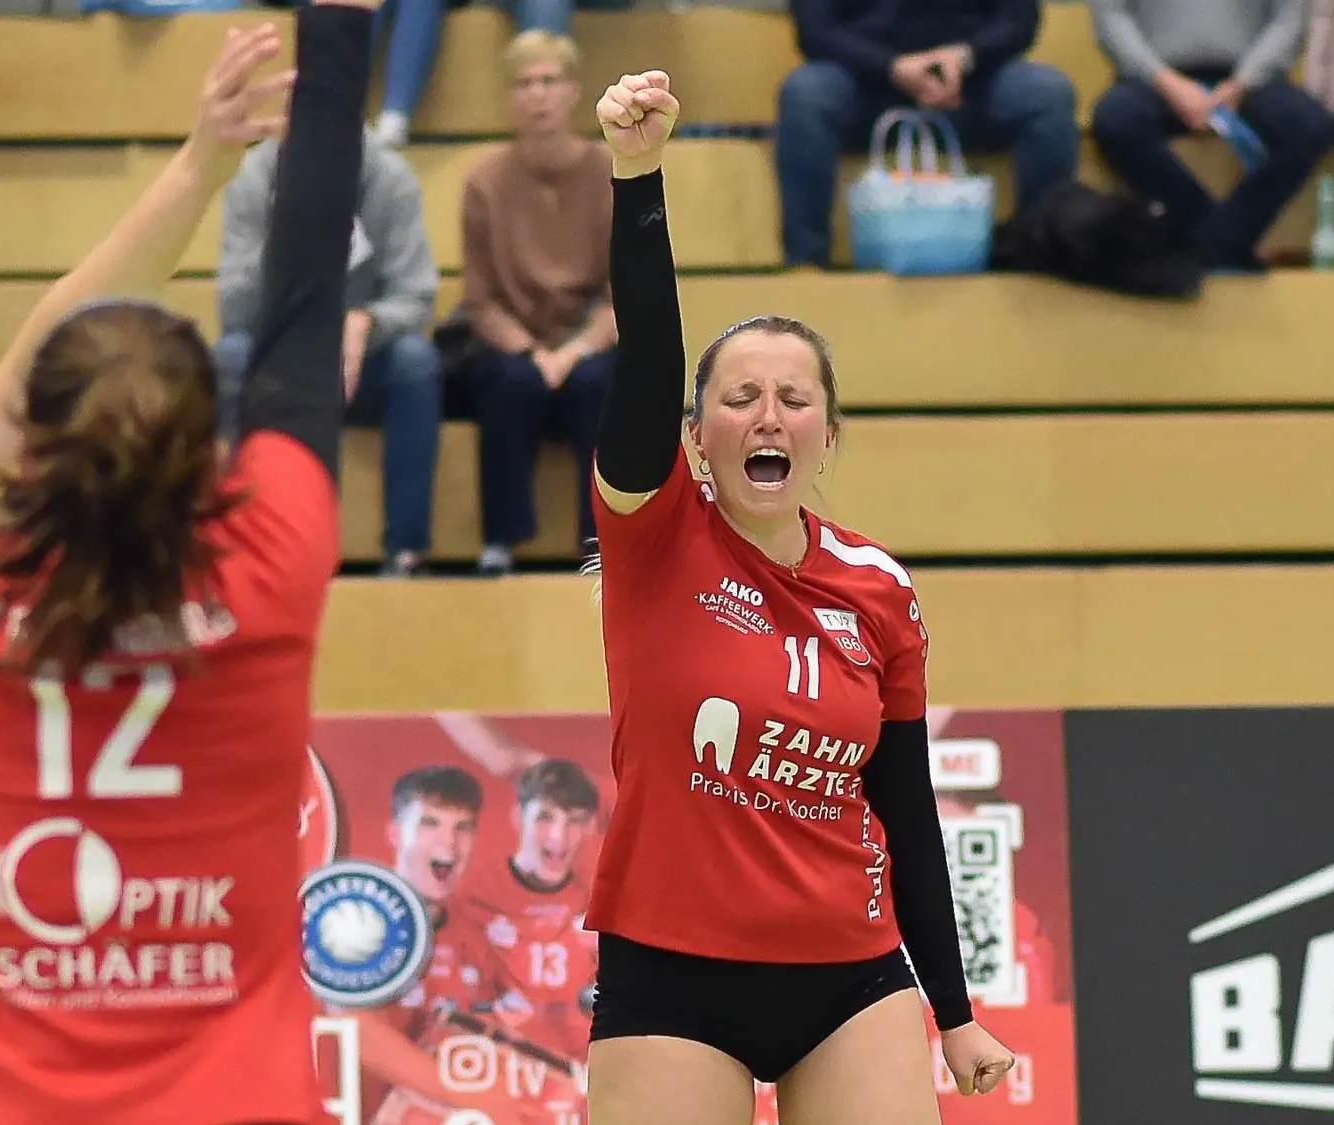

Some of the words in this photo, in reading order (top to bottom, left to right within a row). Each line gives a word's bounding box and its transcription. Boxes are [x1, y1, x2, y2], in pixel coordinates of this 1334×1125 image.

[720, 577, 764, 606] JAKO
[784, 636, 819, 700] 11
[29, 658, 184, 800] 12
[759, 720, 866, 767] ZAHN
[747, 748, 851, 797] ÄRZTE
[754, 792, 782, 814] Dr.
[787, 799, 843, 820] Kocher
[528, 941, 569, 988] 13
